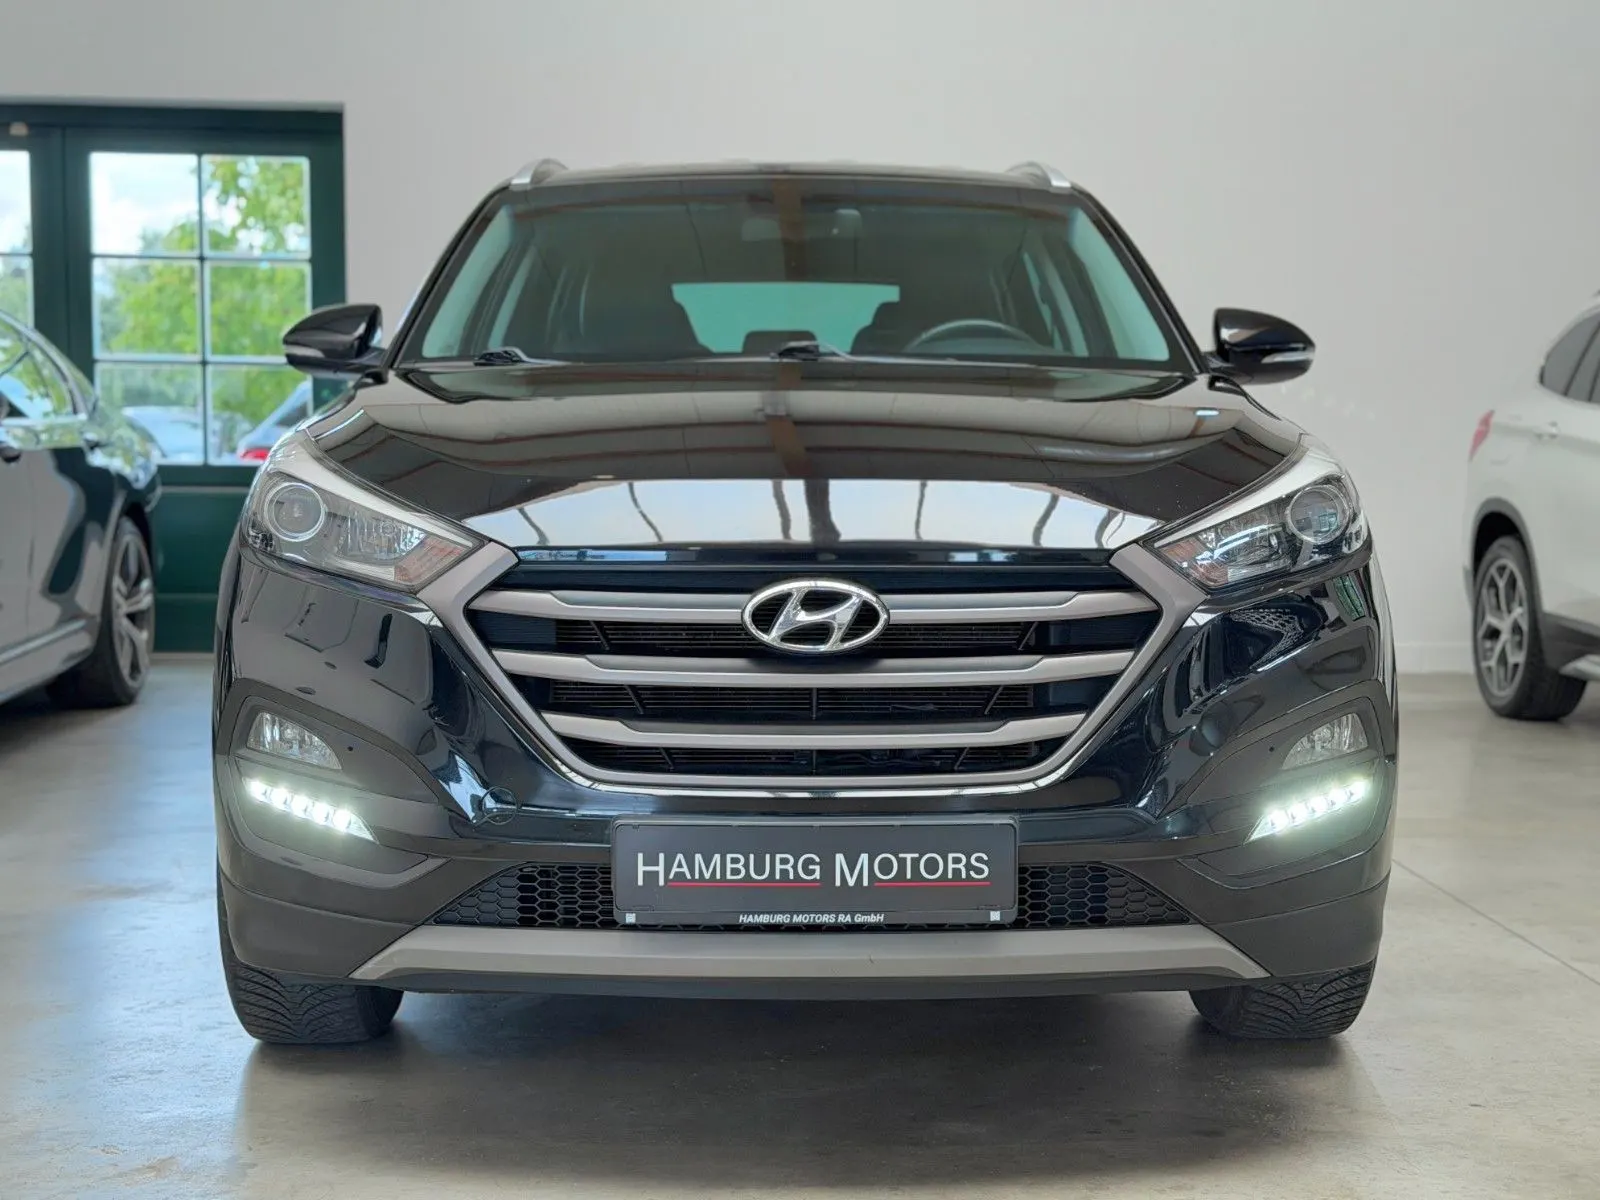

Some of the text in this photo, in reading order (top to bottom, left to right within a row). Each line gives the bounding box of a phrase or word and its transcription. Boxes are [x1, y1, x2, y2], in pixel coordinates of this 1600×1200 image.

[637, 852, 990, 887] HAMBURG MOTORS
[738, 913, 885, 924] HAMBURG MOTORS RA GmbH
